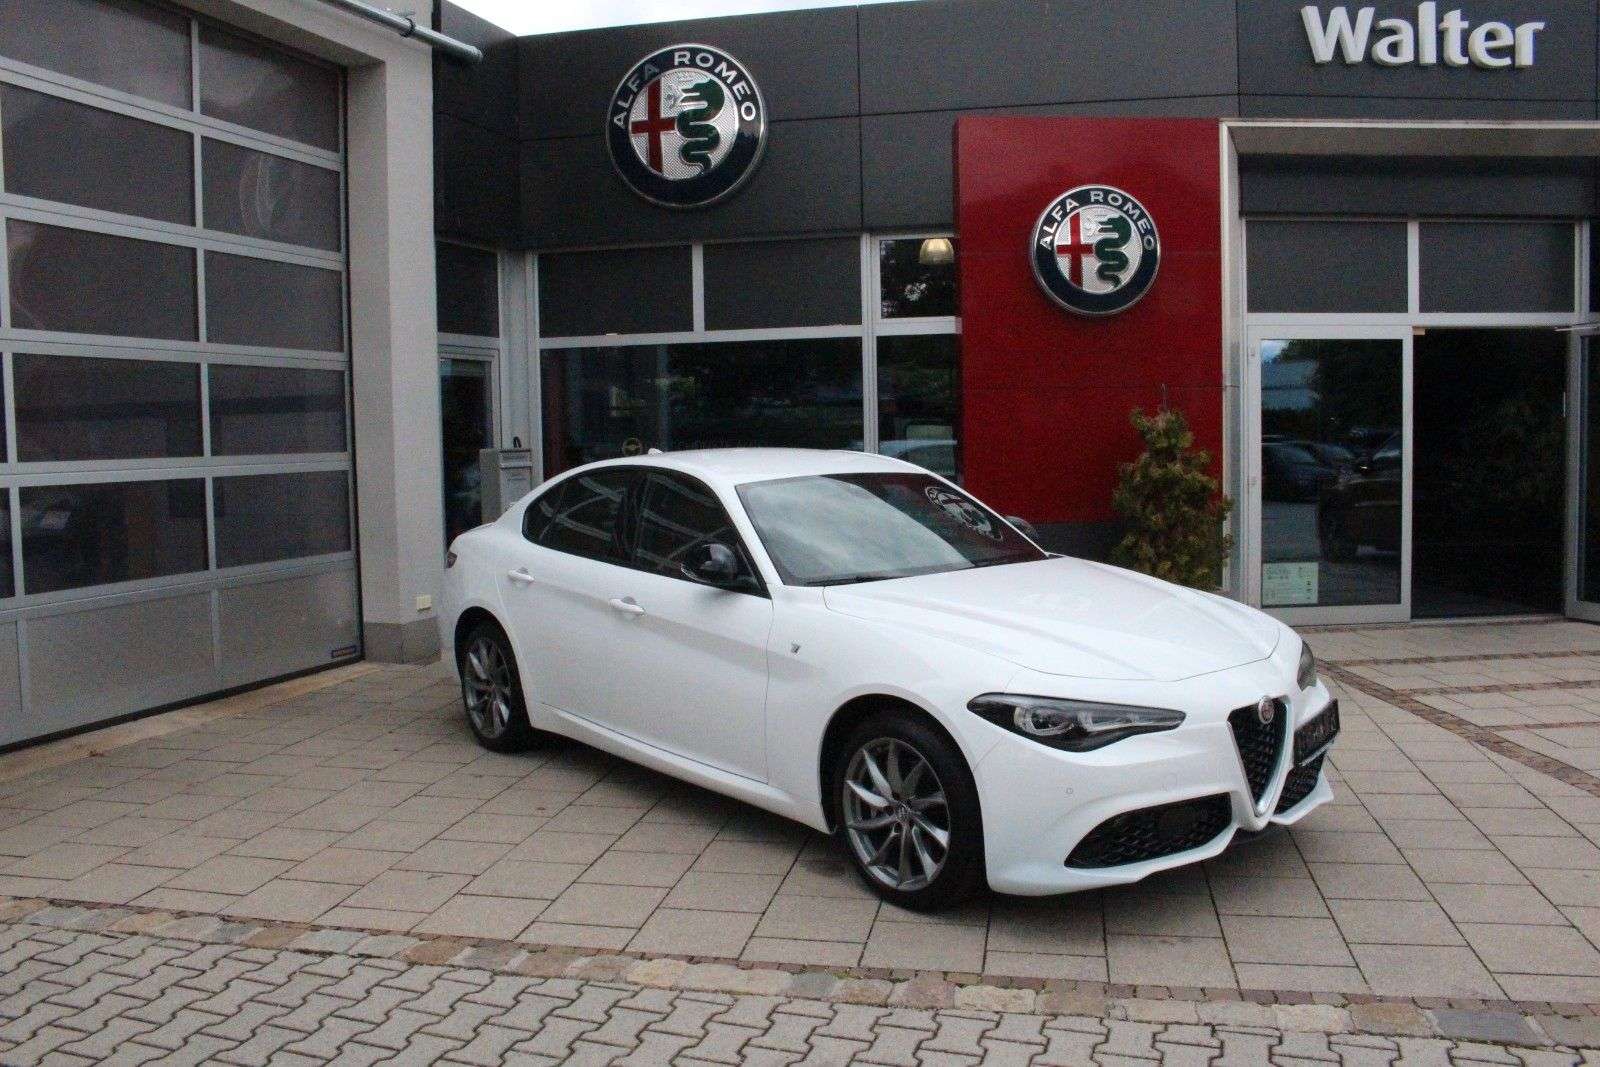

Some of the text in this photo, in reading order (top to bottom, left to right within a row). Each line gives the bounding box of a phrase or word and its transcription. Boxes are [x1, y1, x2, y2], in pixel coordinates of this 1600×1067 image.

[1300, 1, 1545, 69] Walter
[613, 51, 756, 129] ALFA ROMEO
[1040, 190, 1155, 251] ALFA ROMEO
